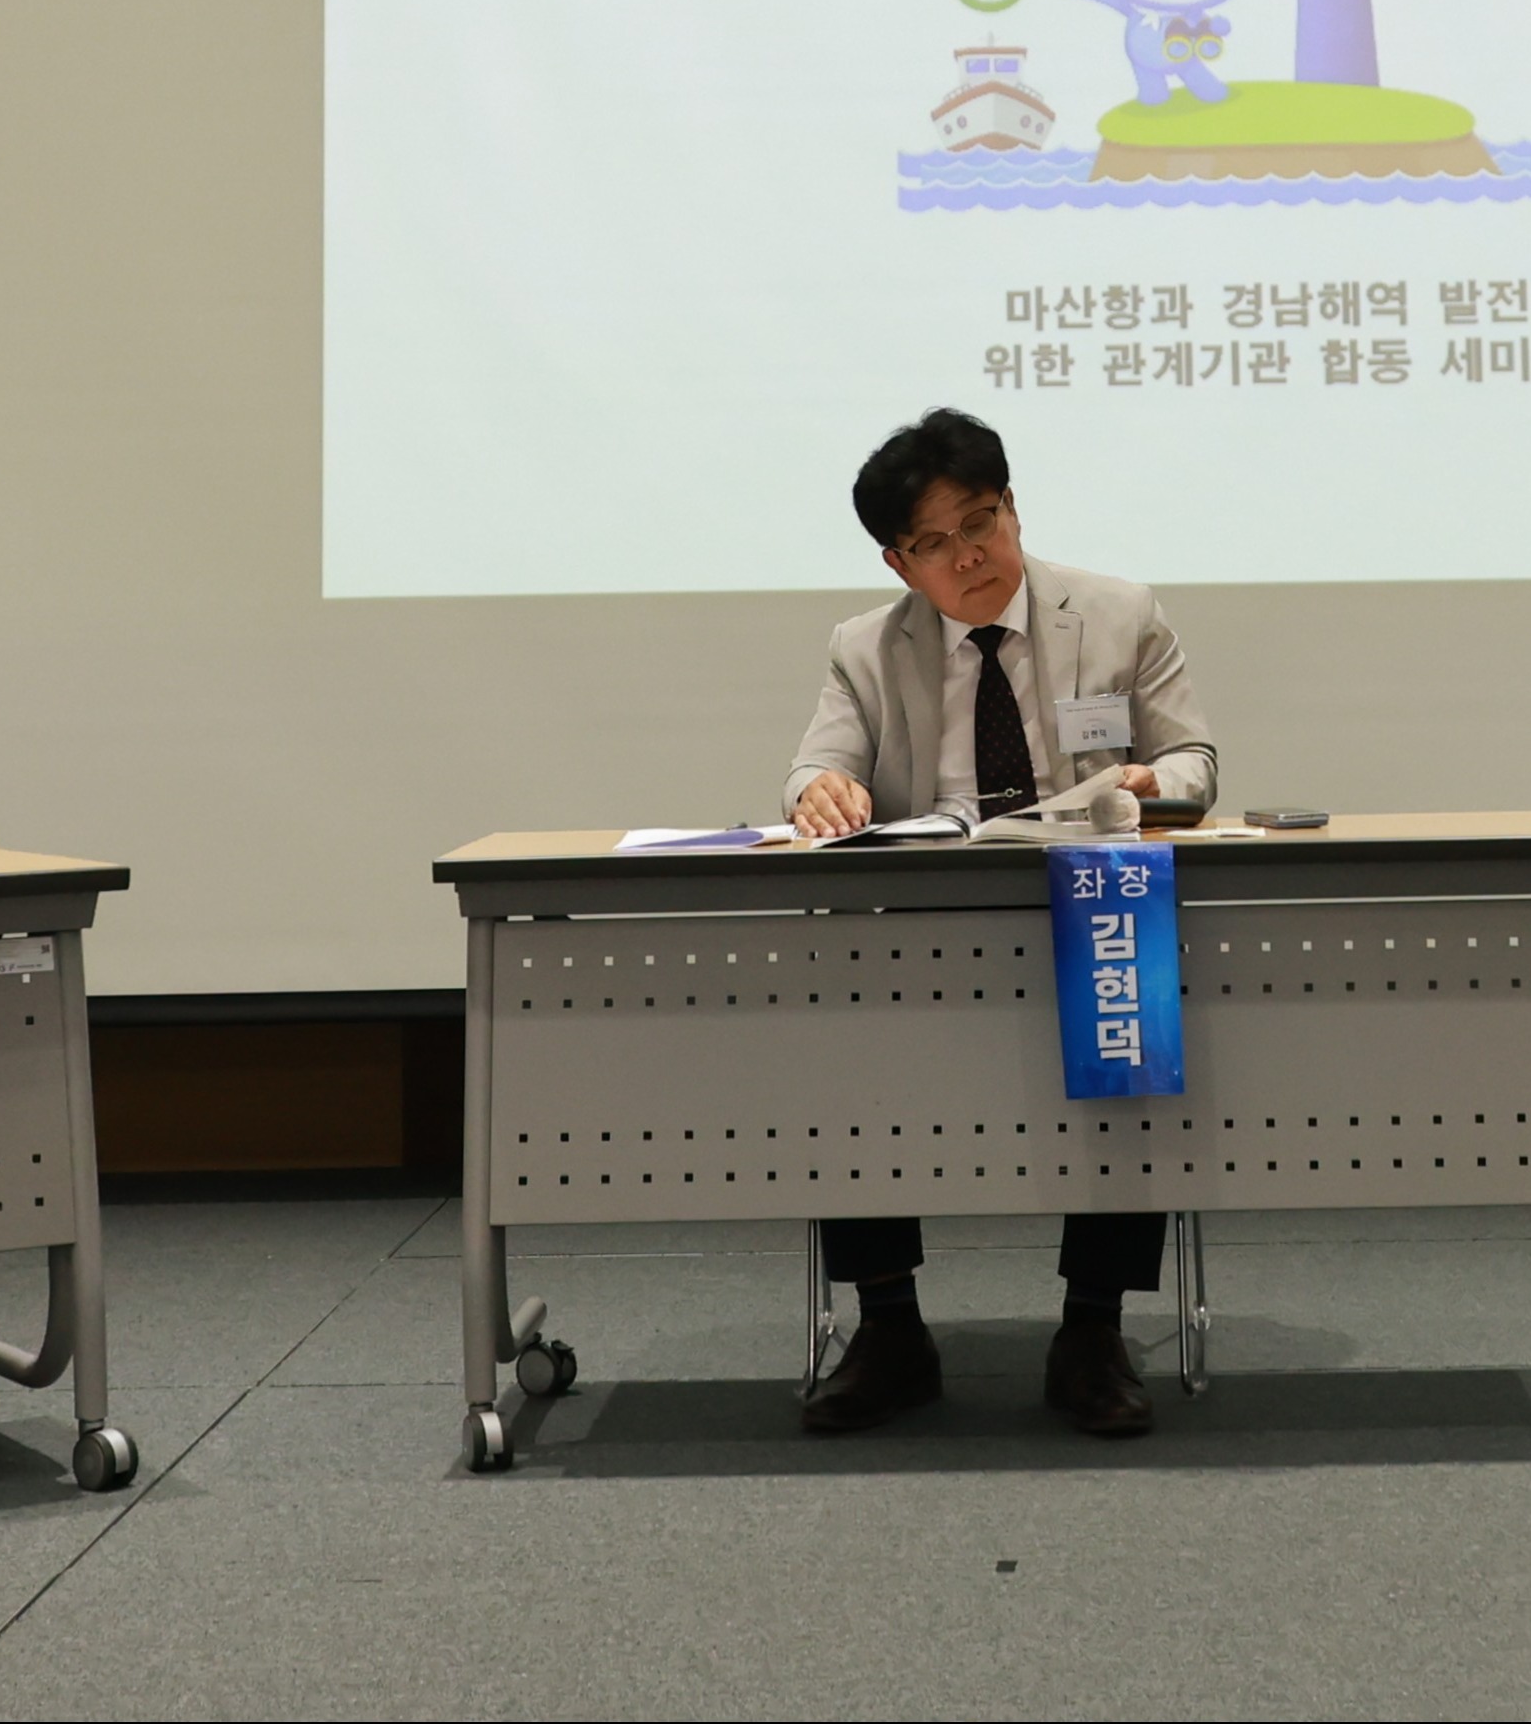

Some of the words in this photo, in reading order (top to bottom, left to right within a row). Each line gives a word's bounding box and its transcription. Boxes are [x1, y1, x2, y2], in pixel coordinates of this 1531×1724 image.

[1006, 283, 1194, 331] 마산항과
[1223, 280, 1408, 328] 경남해역
[983, 343, 1075, 390] 위한
[1102, 339, 1291, 387] 관계기관
[1319, 339, 1412, 386] 합동
[1091, 913, 1141, 1066] 김현덕
